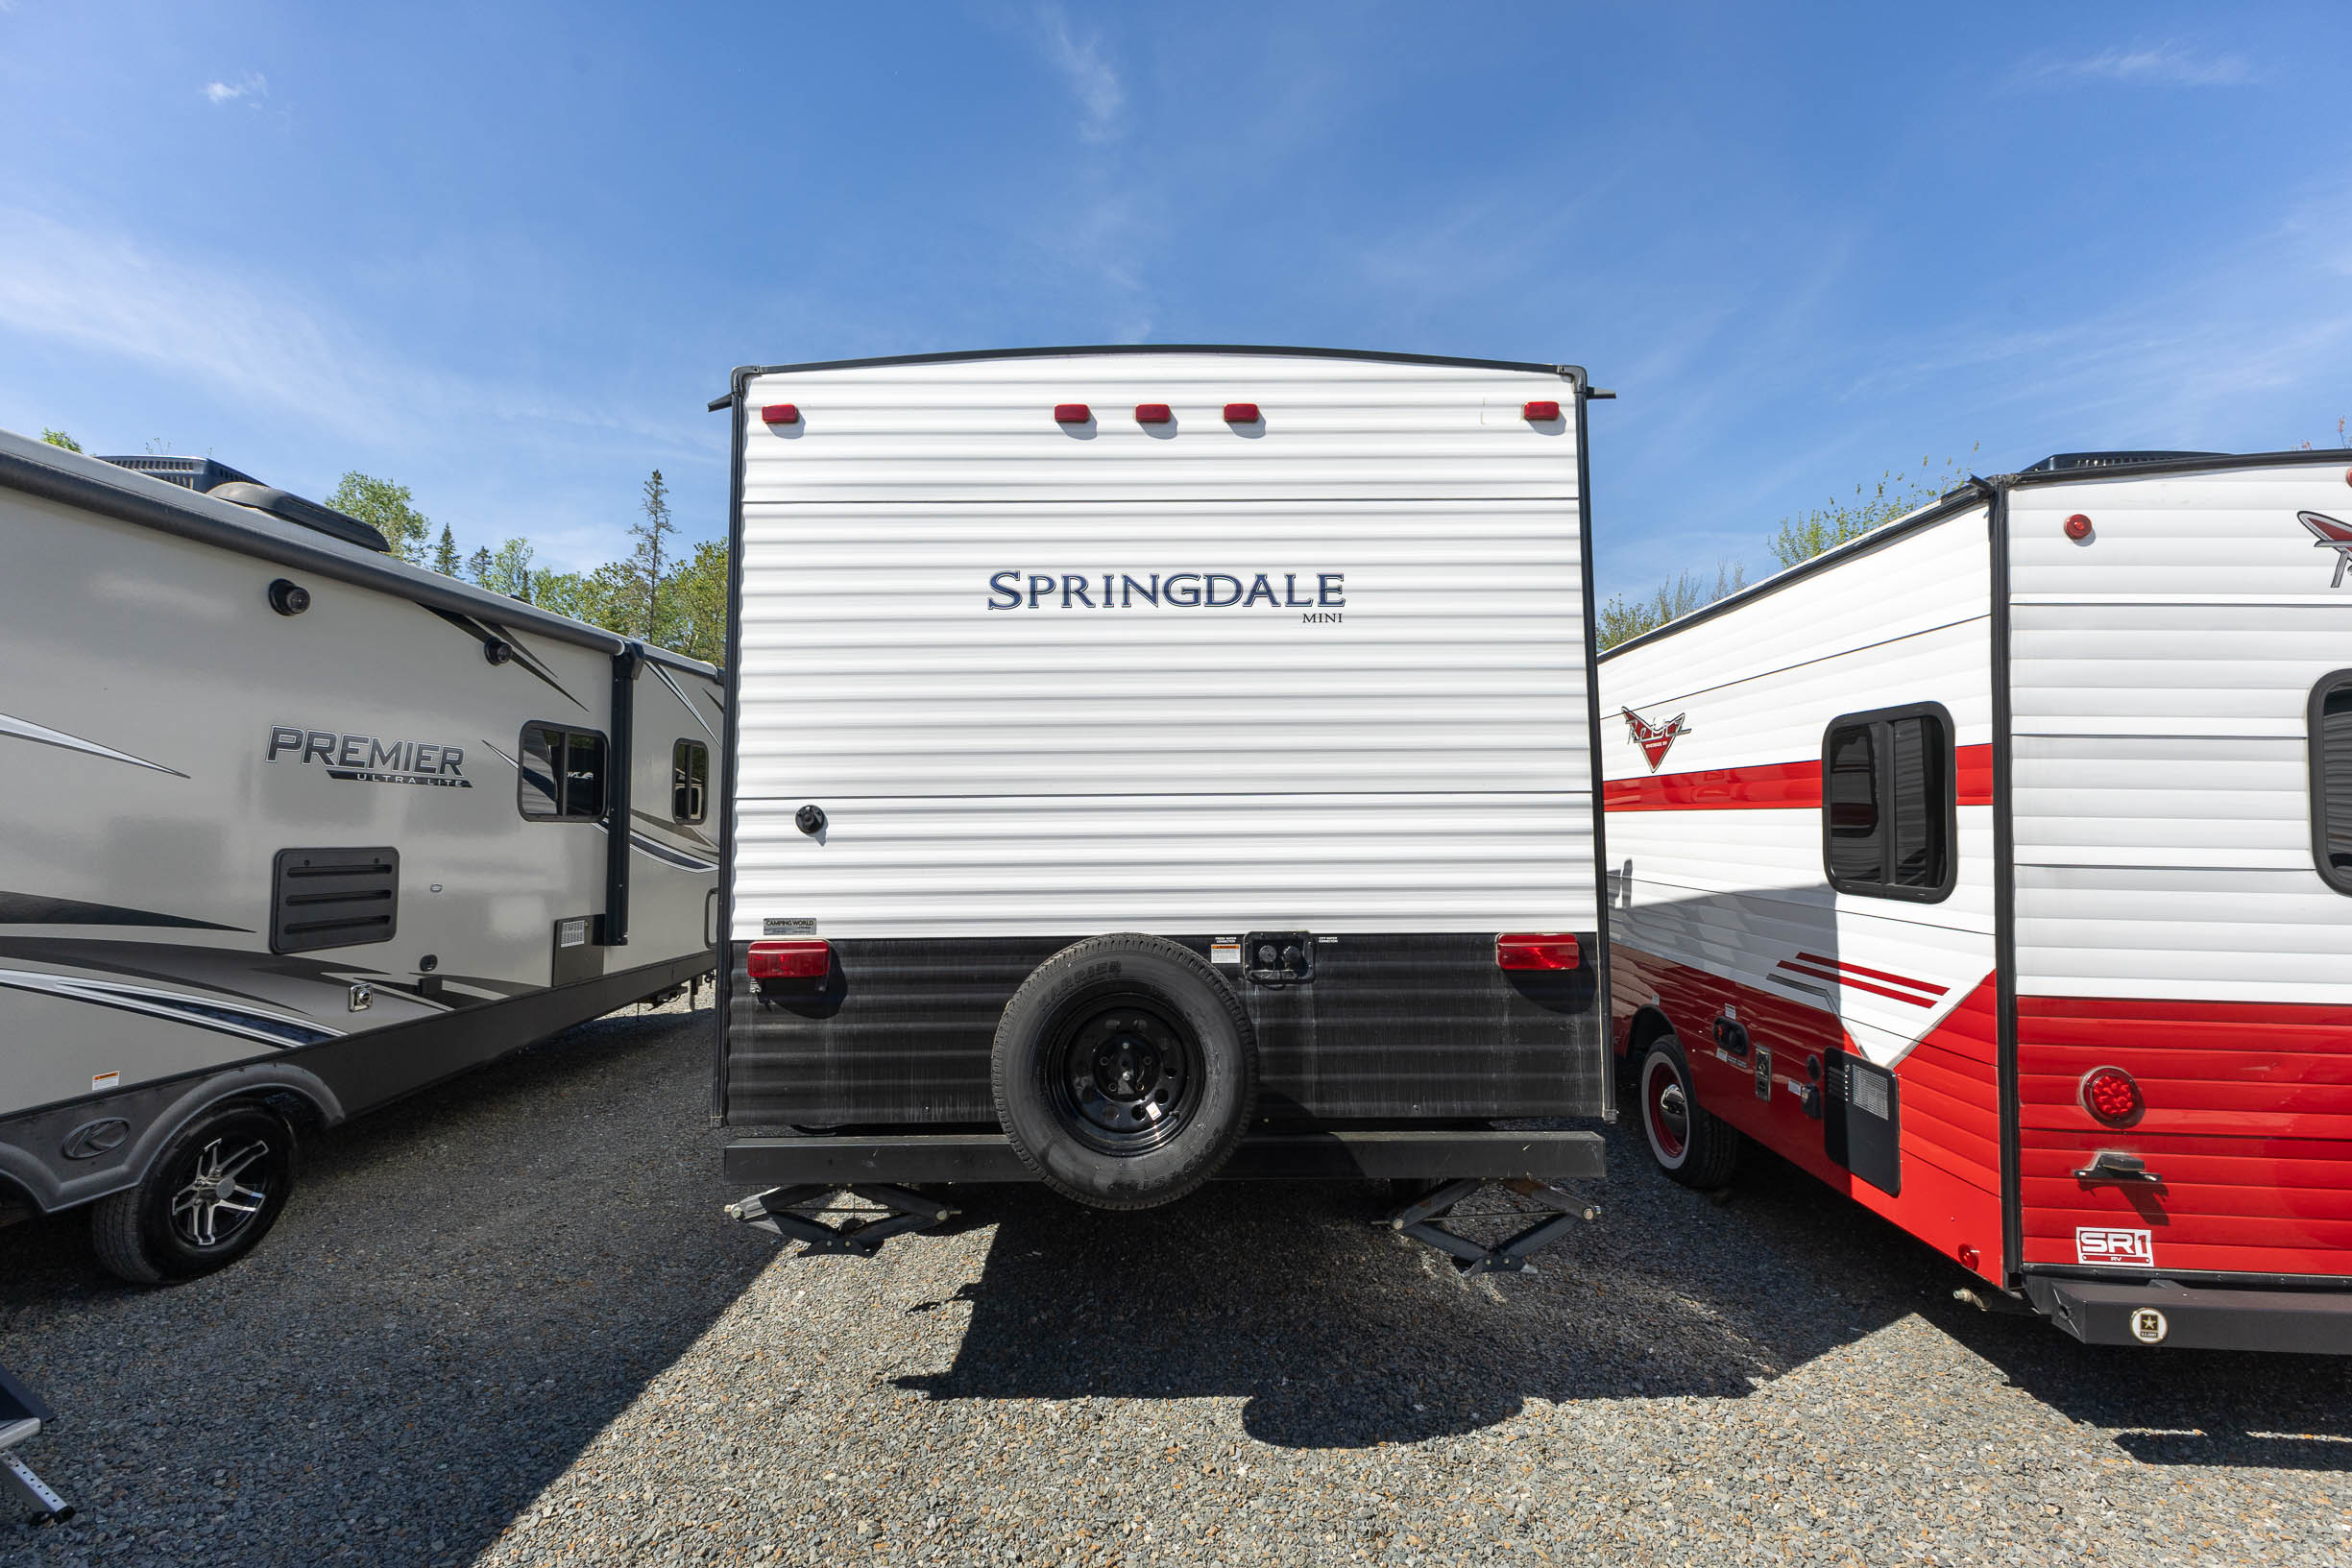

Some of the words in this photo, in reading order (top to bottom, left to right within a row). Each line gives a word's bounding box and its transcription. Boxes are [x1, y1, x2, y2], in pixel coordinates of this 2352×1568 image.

[987, 569, 1346, 610] SPRINGDALE
[1302, 613, 1344, 623] MINI
[265, 725, 466, 777] PREMIER
[356, 773, 417, 784] ULTRA
[427, 778, 463, 787] LITE
